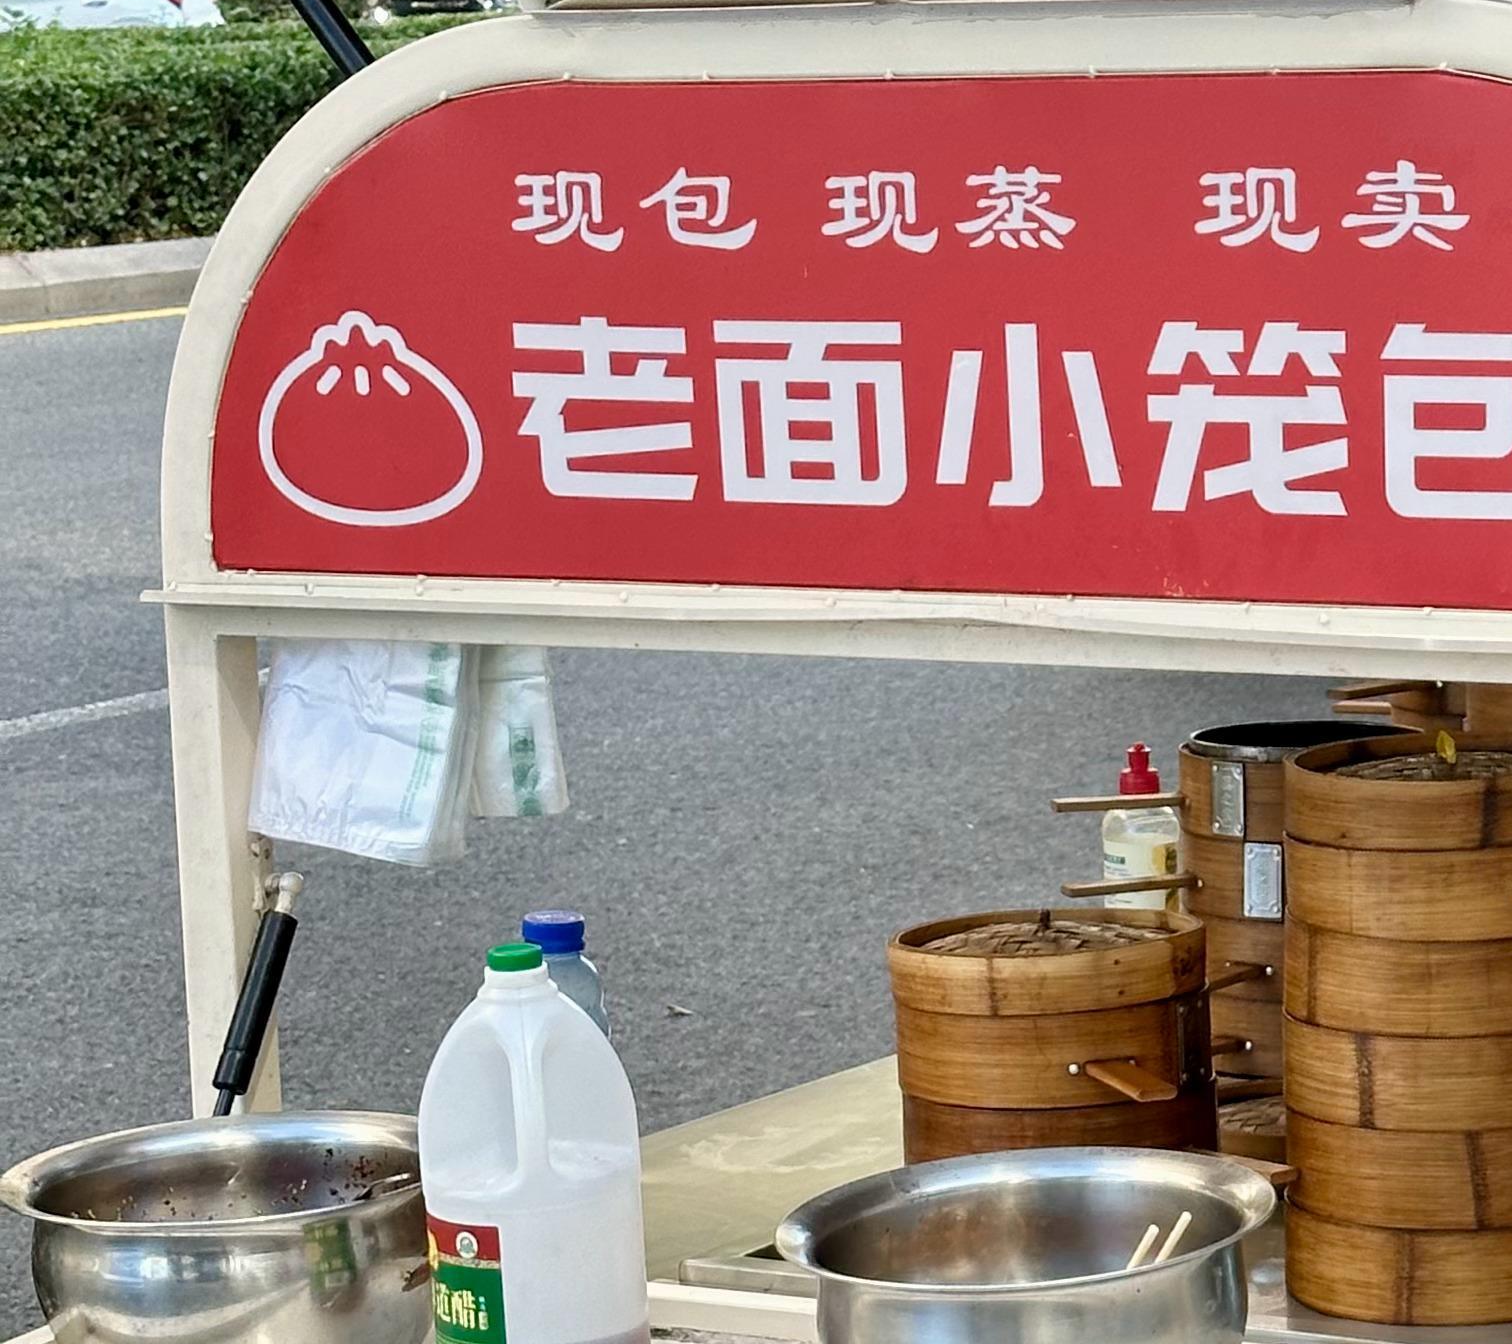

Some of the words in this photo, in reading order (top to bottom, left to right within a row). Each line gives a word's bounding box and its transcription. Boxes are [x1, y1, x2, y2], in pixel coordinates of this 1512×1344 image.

[512, 167, 757, 252] 现包
[821, 165, 1077, 254] 现蒸
[1194, 159, 1471, 253] 现卖
